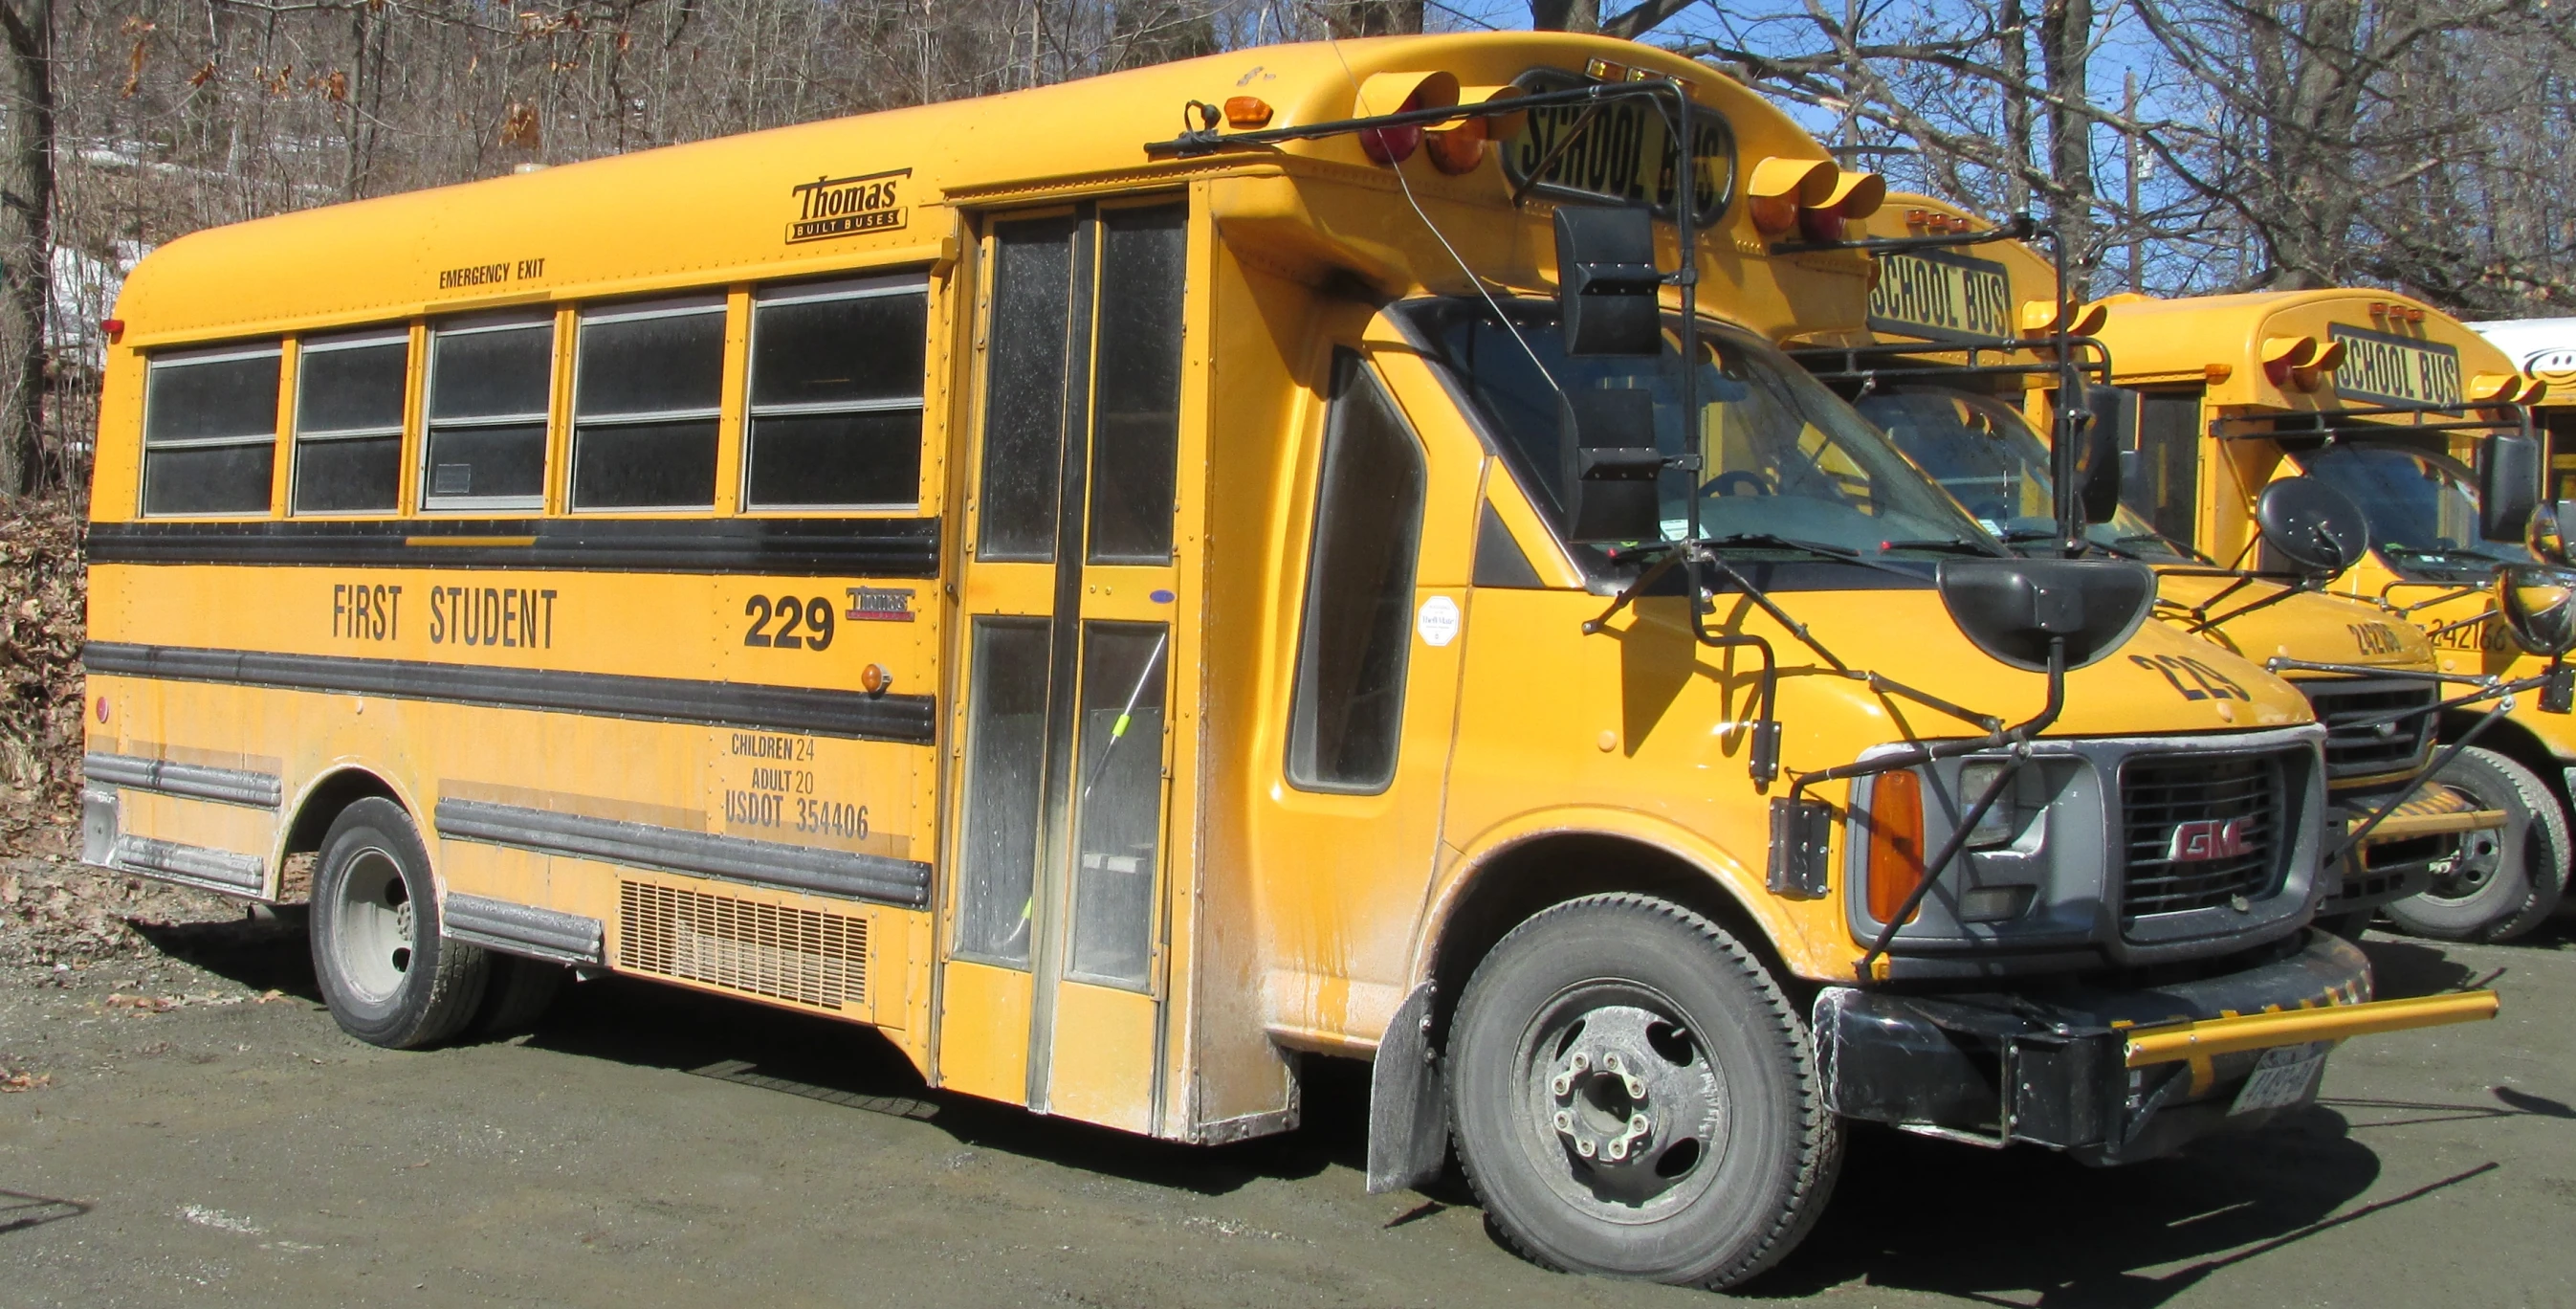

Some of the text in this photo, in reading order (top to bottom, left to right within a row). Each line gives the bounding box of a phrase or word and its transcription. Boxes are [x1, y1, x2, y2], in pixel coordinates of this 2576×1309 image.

[1522, 84, 1645, 200] SCHOOL
[792, 167, 913, 220] Thomas
[797, 212, 894, 236] BUILT BUSES
[439, 257, 545, 289] EMERGENCY EXIT
[1871, 255, 2006, 337] SCHOOL BUS
[2336, 336, 2457, 405] SCHOOL BUS
[333, 584, 558, 649] FIRST STUDENT
[744, 594, 834, 652] 229
[2127, 654, 2251, 702] 229
[732, 733, 815, 762] CHILDREN 24
[752, 767, 813, 794] ADULT 20
[725, 789, 869, 841] USDOT 354406
[2168, 815, 2257, 861] GMC
